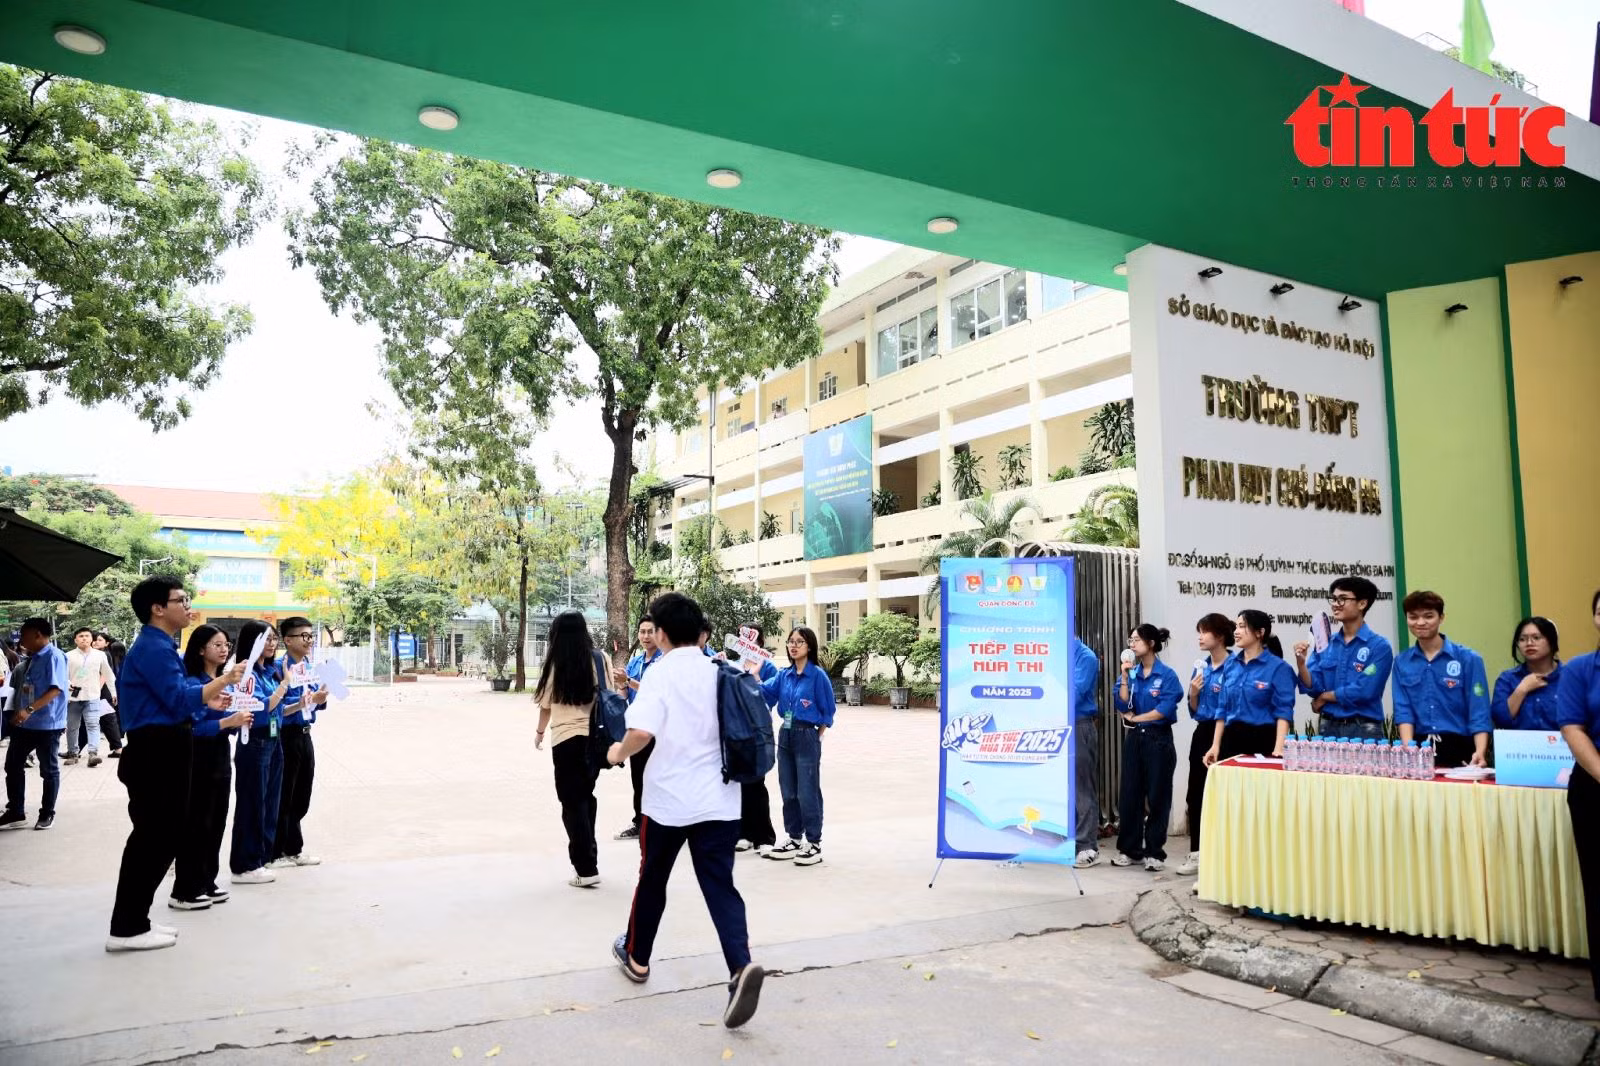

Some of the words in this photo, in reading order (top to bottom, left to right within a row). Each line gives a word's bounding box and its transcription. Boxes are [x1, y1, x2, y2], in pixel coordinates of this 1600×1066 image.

[1168, 293, 1191, 318] SỞ
[1192, 302, 1229, 326] GIÁO
[1231, 311, 1260, 334] DỤC
[1353, 338, 1375, 360] NỘI
[1201, 374, 1301, 429] TRƯỜNG
[1305, 393, 1359, 438] THPT
[1183, 455, 1236, 502] PHAN
[1238, 463, 1273, 506] HUY
[1216, 582, 1238, 596] 3773
[968, 640, 1007, 655] TIẾP
[1013, 641, 1049, 655] SỨC
[973, 659, 1009, 673] MÙA
[1015, 660, 1044, 673] THI
[982, 686, 1006, 697] NĂM
[1008, 688, 1032, 697] 2025
[1016, 729, 1065, 752] 2025
